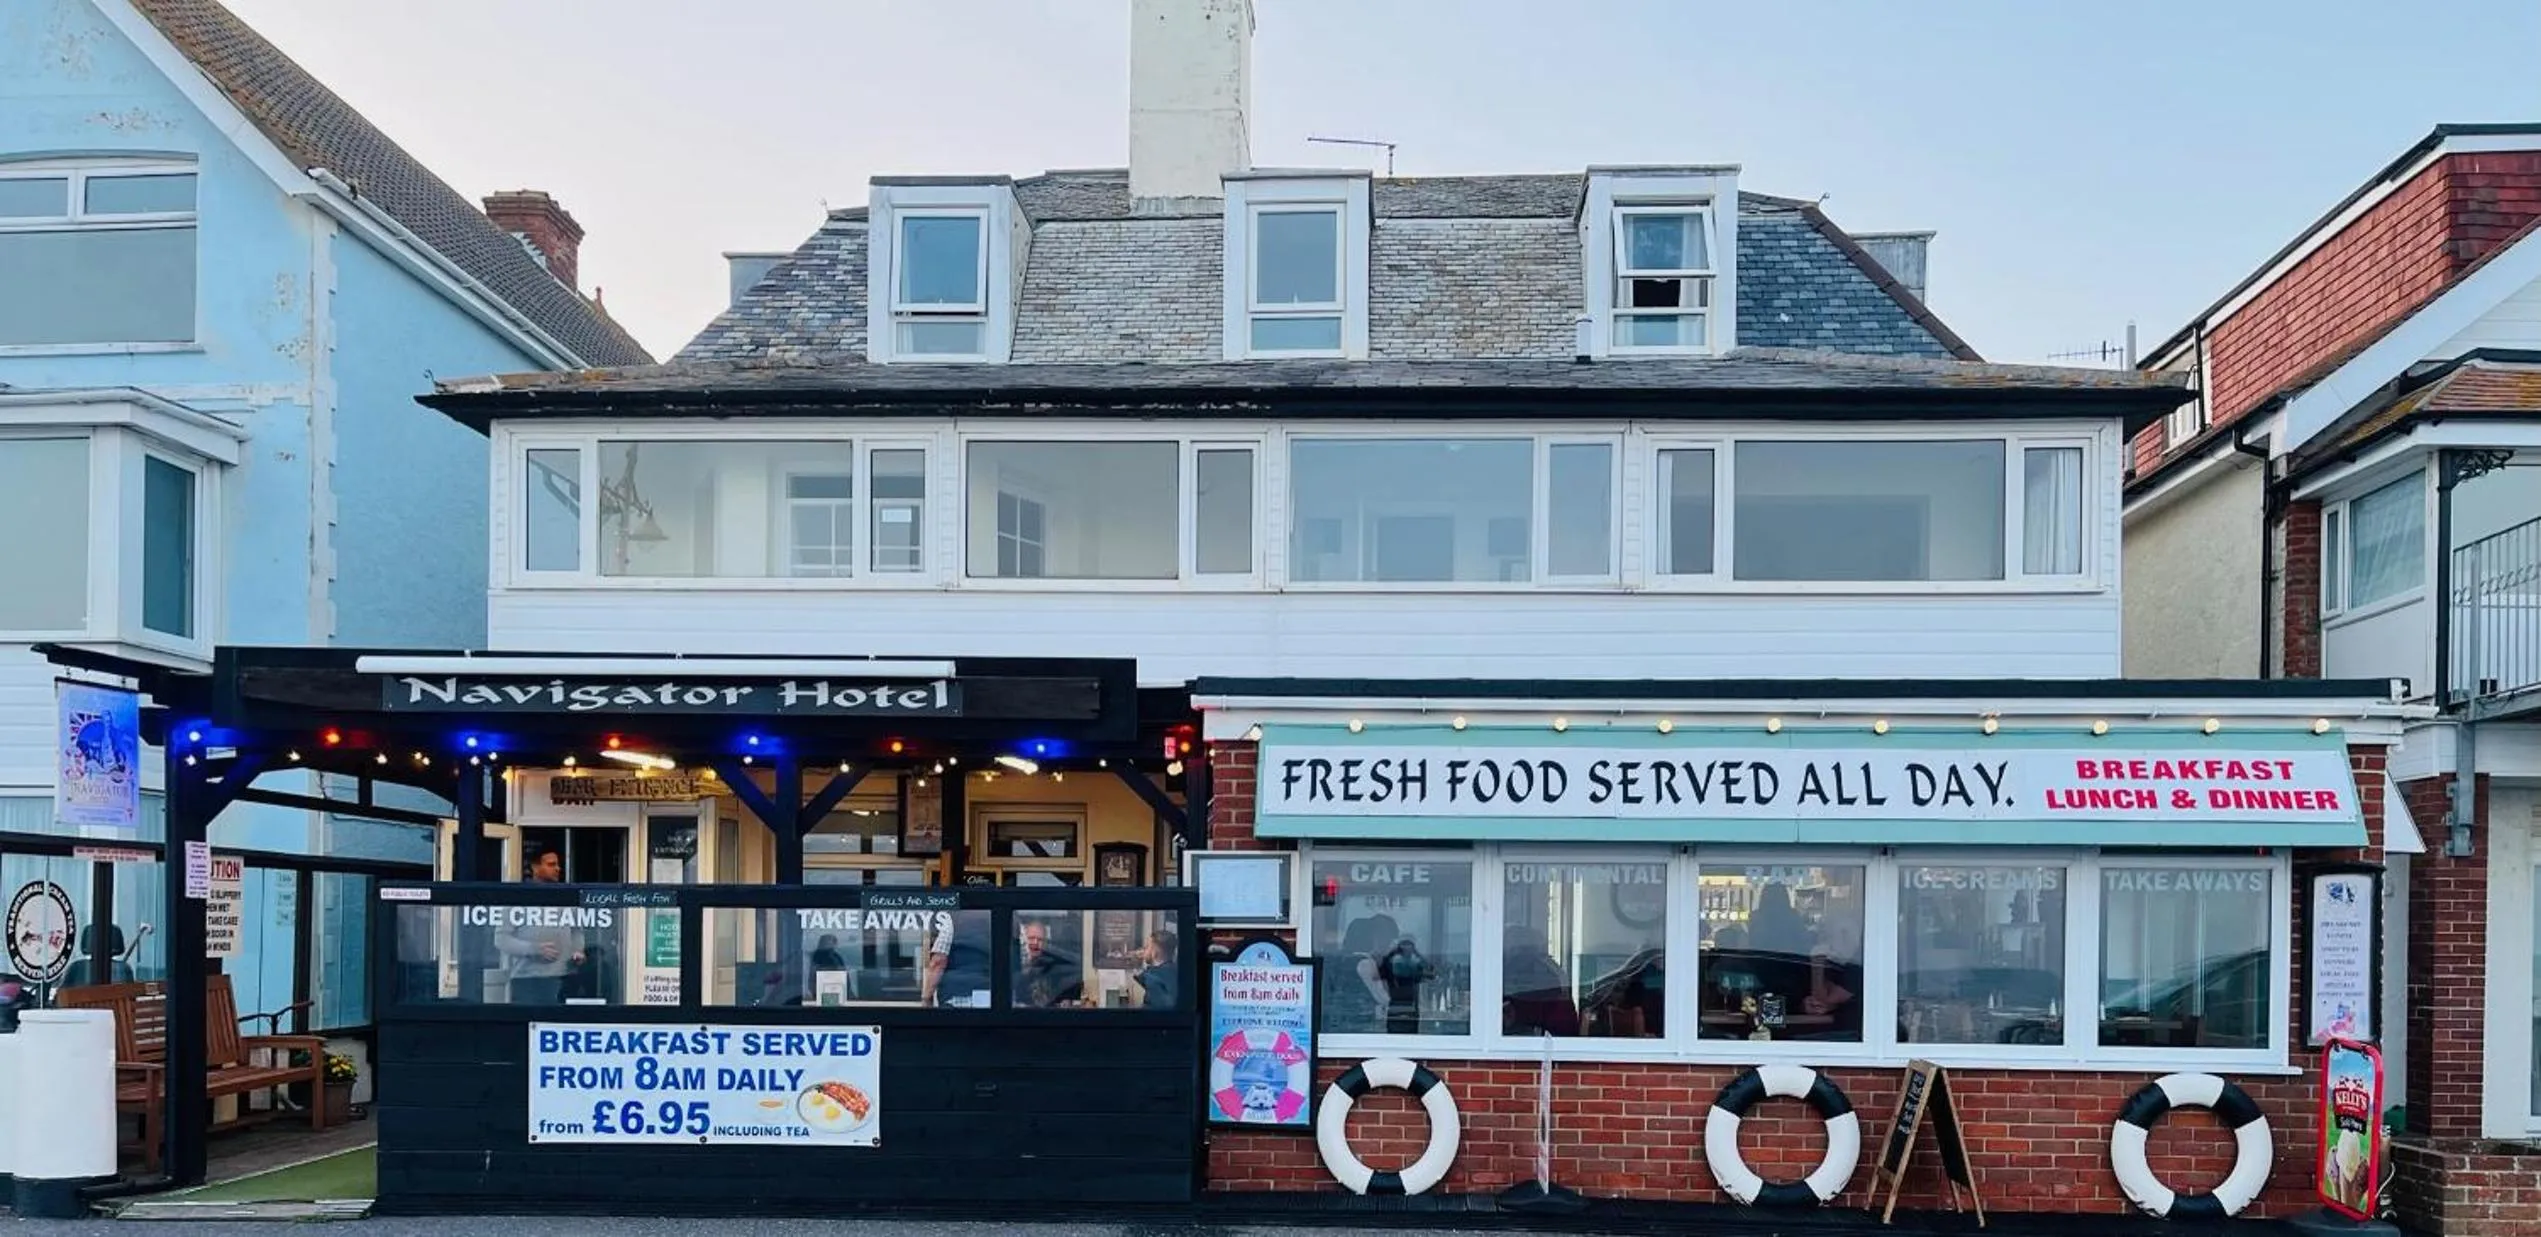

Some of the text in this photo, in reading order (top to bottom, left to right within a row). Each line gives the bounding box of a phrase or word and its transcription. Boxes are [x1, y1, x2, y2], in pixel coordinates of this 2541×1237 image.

[402, 677, 948, 712] Navigator Hotel
[2076, 760, 2294, 780] BREAKFAST
[609, 777, 701, 797] ENTRANCE
[1281, 757, 2015, 807] FRESH FOOD SERVED ALL DAY.
[2046, 789, 2340, 810] LUNCH & DINNER
[1351, 864, 1431, 883] CAFE
[1904, 870, 2058, 891] ICE CREAMS
[2106, 871, 2264, 892] TAKE AWAYS
[463, 905, 613, 928] ICE CREAMS
[796, 909, 952, 931] TAKE AWAYS
[1220, 968, 1304, 984] Breakfast served
[1223, 987, 1248, 1001] from
[539, 1031, 872, 1057] BREAKFAST SERVED
[540, 1056, 804, 1092] FROM 8AM DAILY
[539, 1101, 810, 1138] from £6.95 INCLUDING TEA
